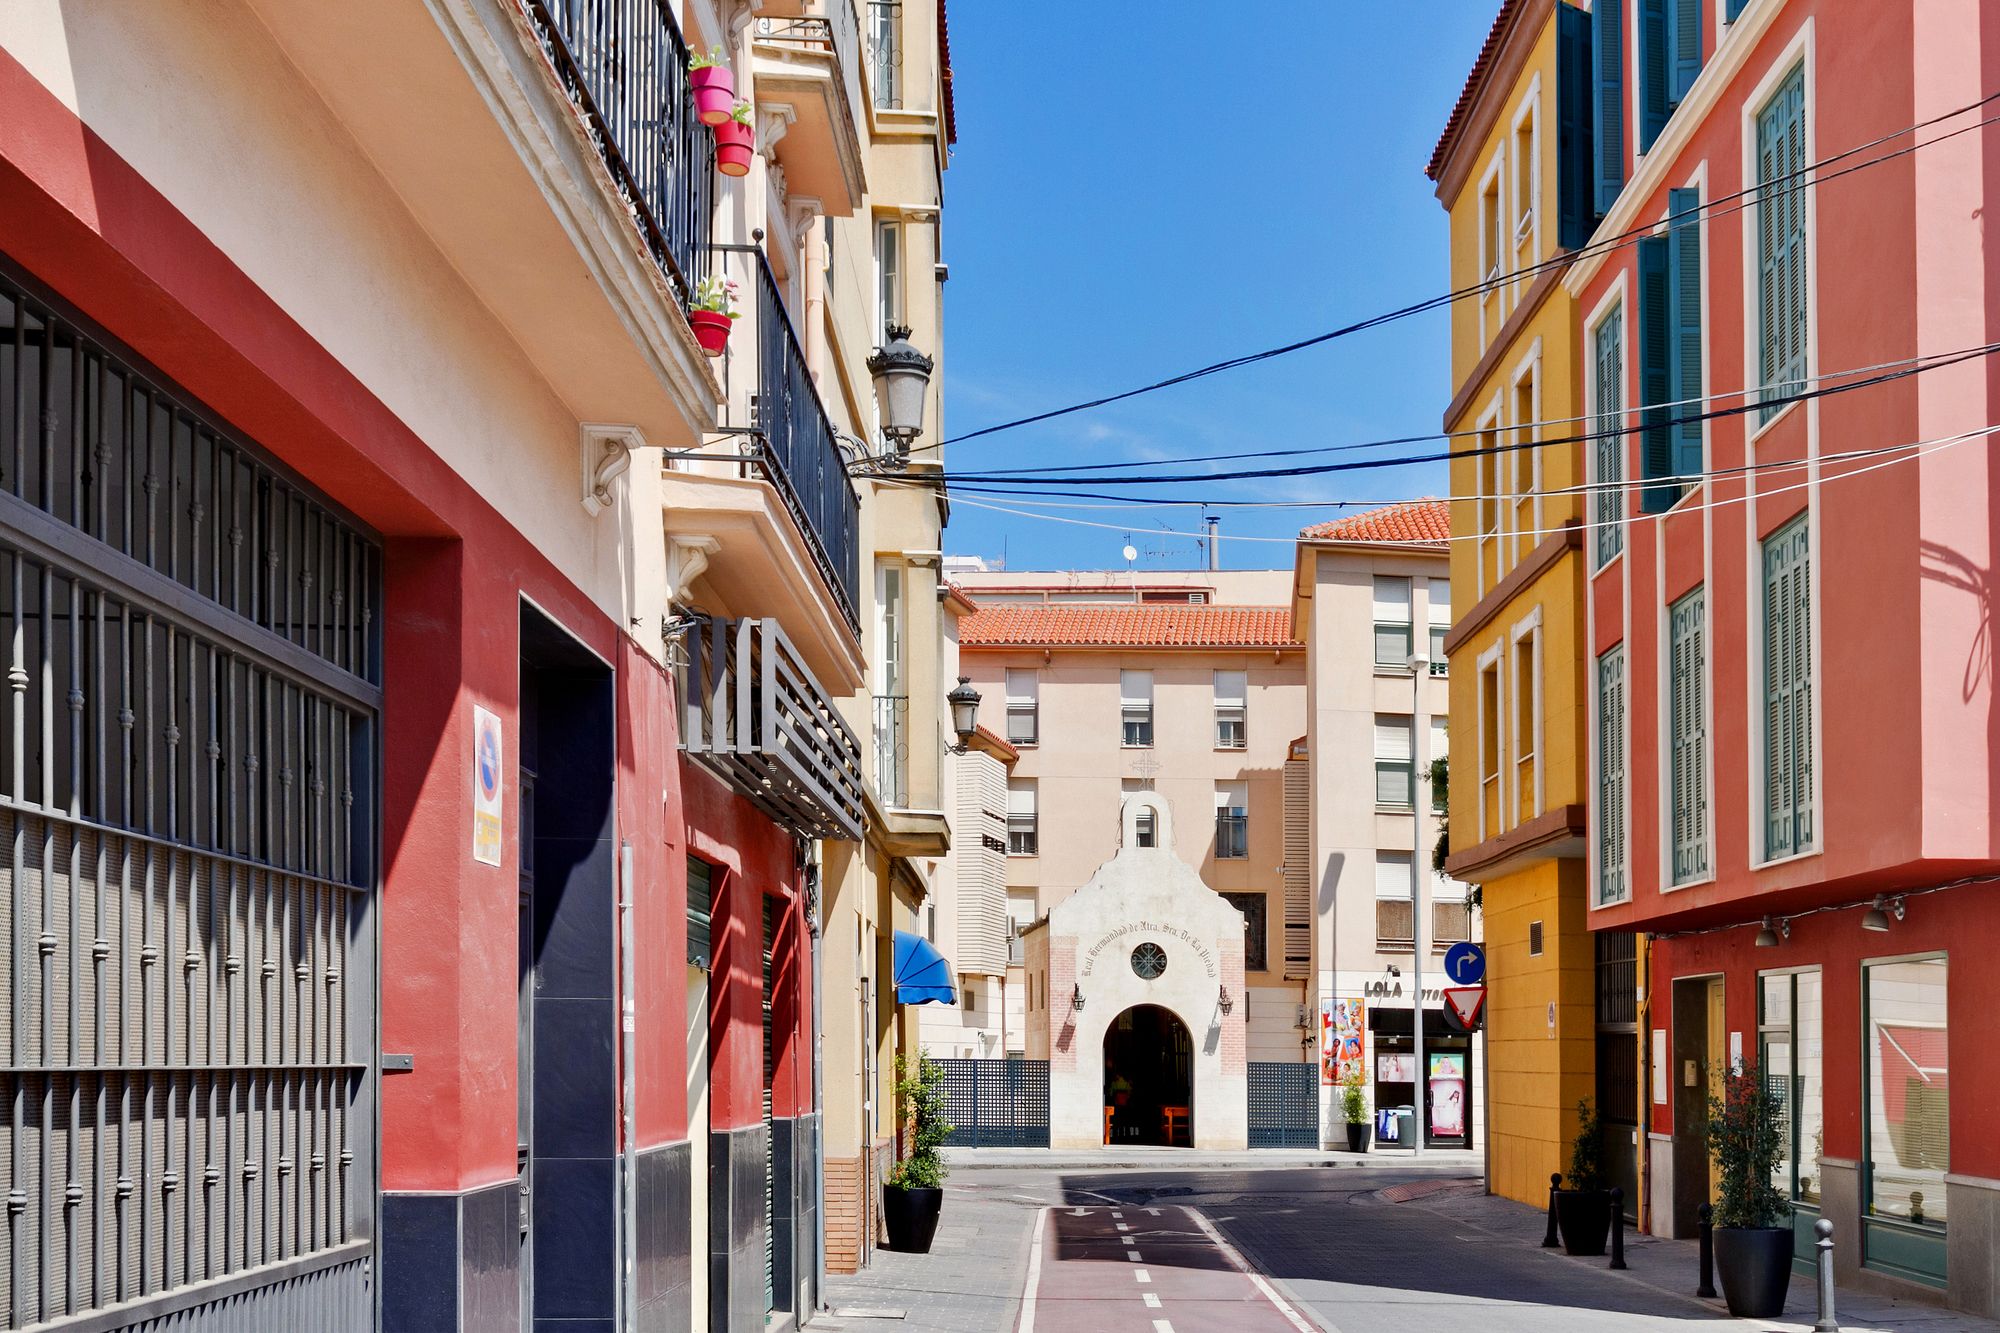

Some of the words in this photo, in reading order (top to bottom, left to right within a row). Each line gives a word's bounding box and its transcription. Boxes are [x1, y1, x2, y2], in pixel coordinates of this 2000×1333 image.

[1081, 956, 1094, 977] Real
[1088, 925, 1128, 957] Hermandad
[1163, 923, 1178, 937] Sra.
[1199, 948, 1217, 978] Piedad
[1364, 981, 1402, 998] LOLA
